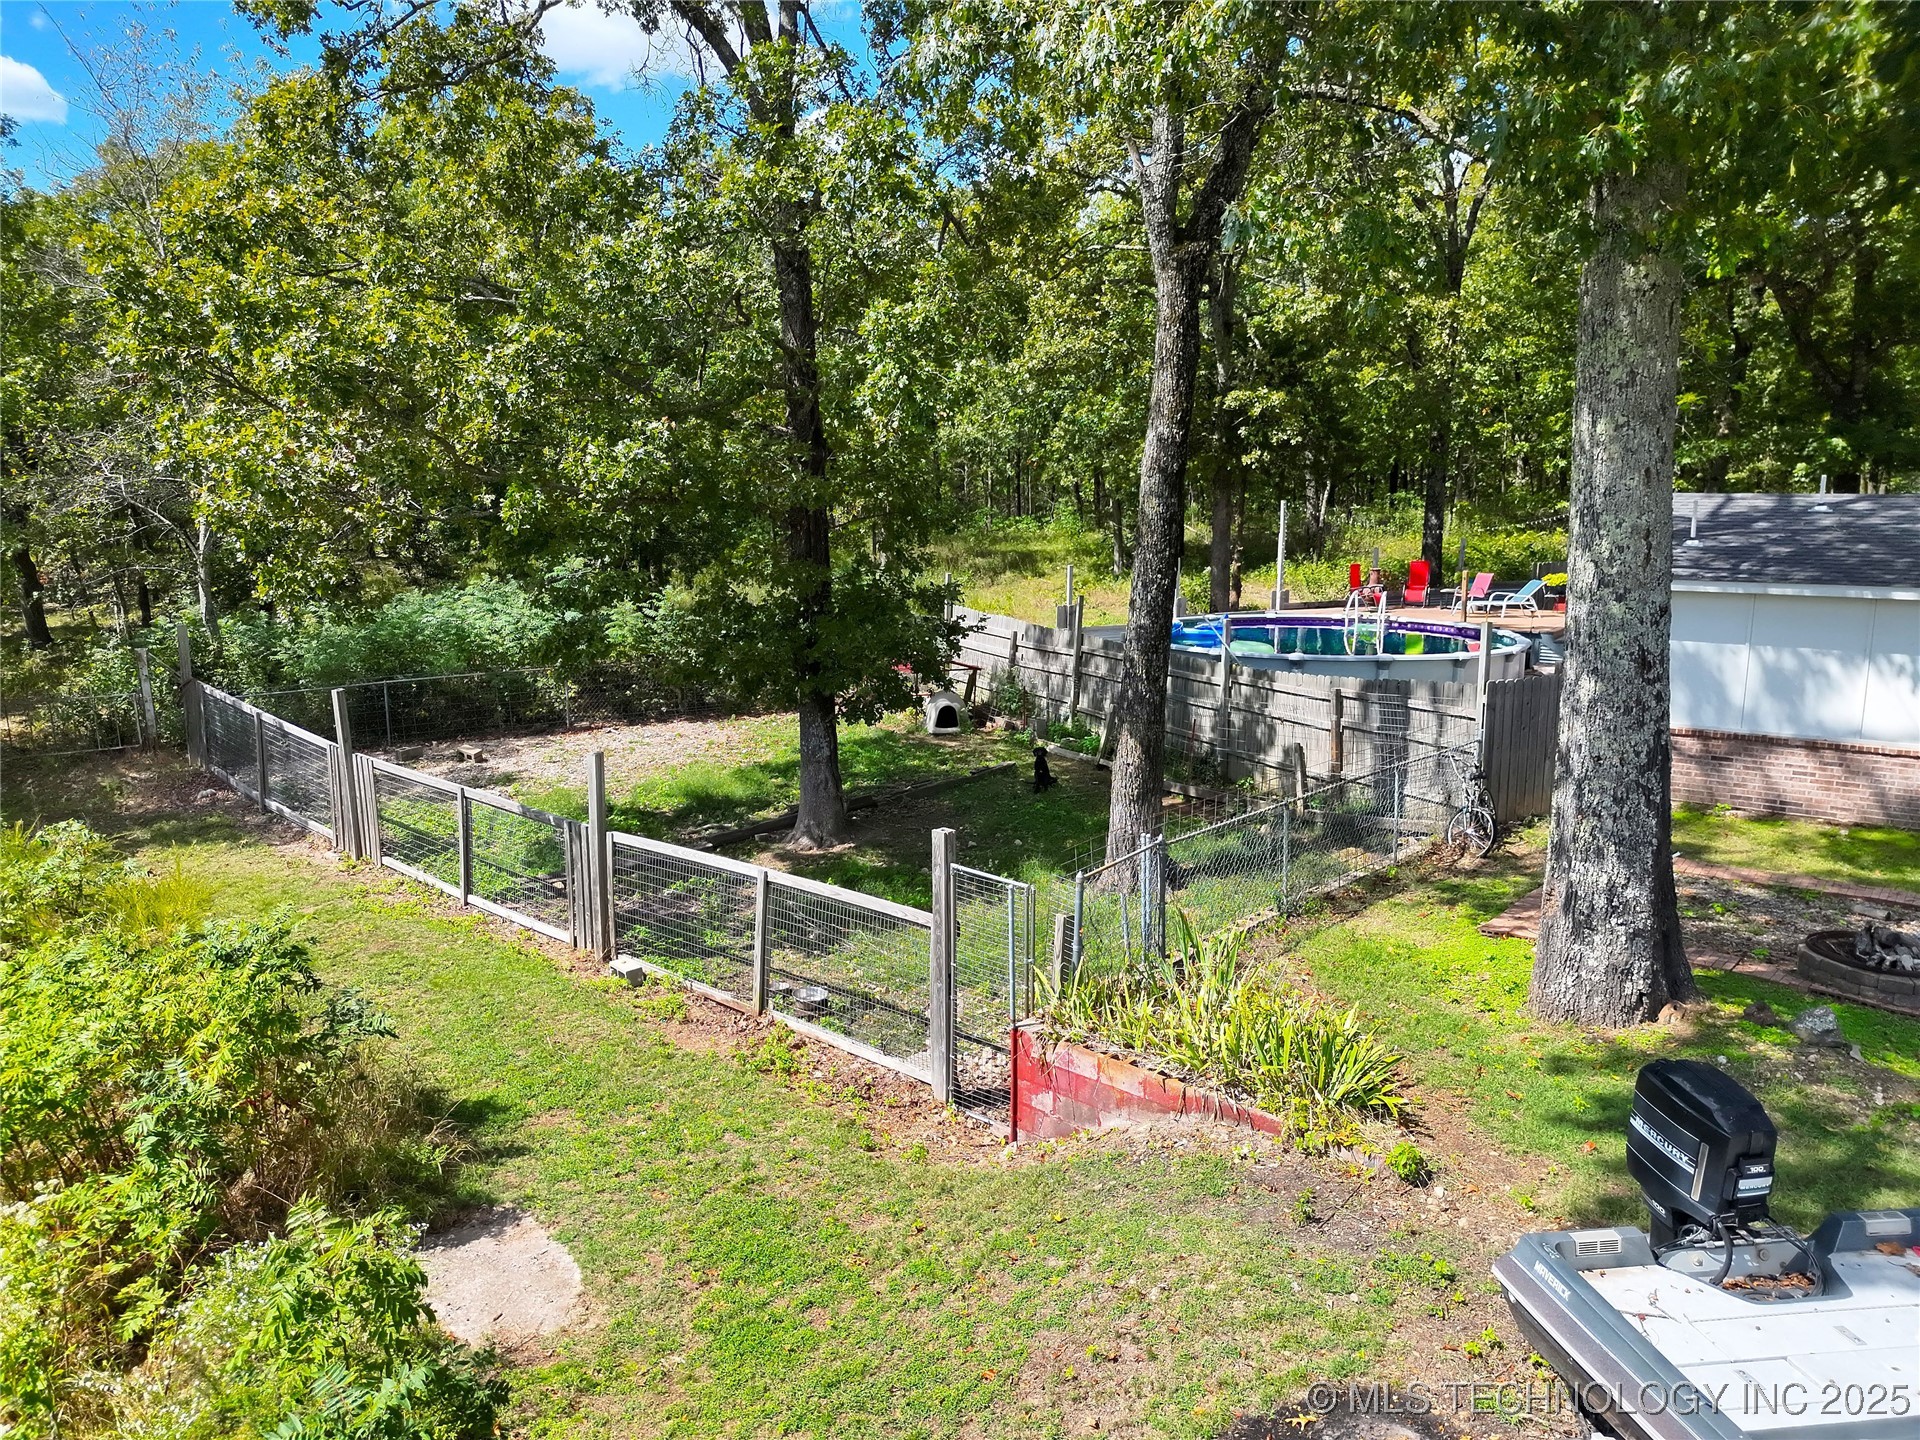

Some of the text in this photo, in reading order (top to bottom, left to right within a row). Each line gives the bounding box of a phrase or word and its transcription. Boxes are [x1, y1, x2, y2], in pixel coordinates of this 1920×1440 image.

[1635, 1115, 1690, 1163] MERCURY
[1651, 1199, 1666, 1215] 100
[1533, 1260, 1571, 1301] MAVERICK
